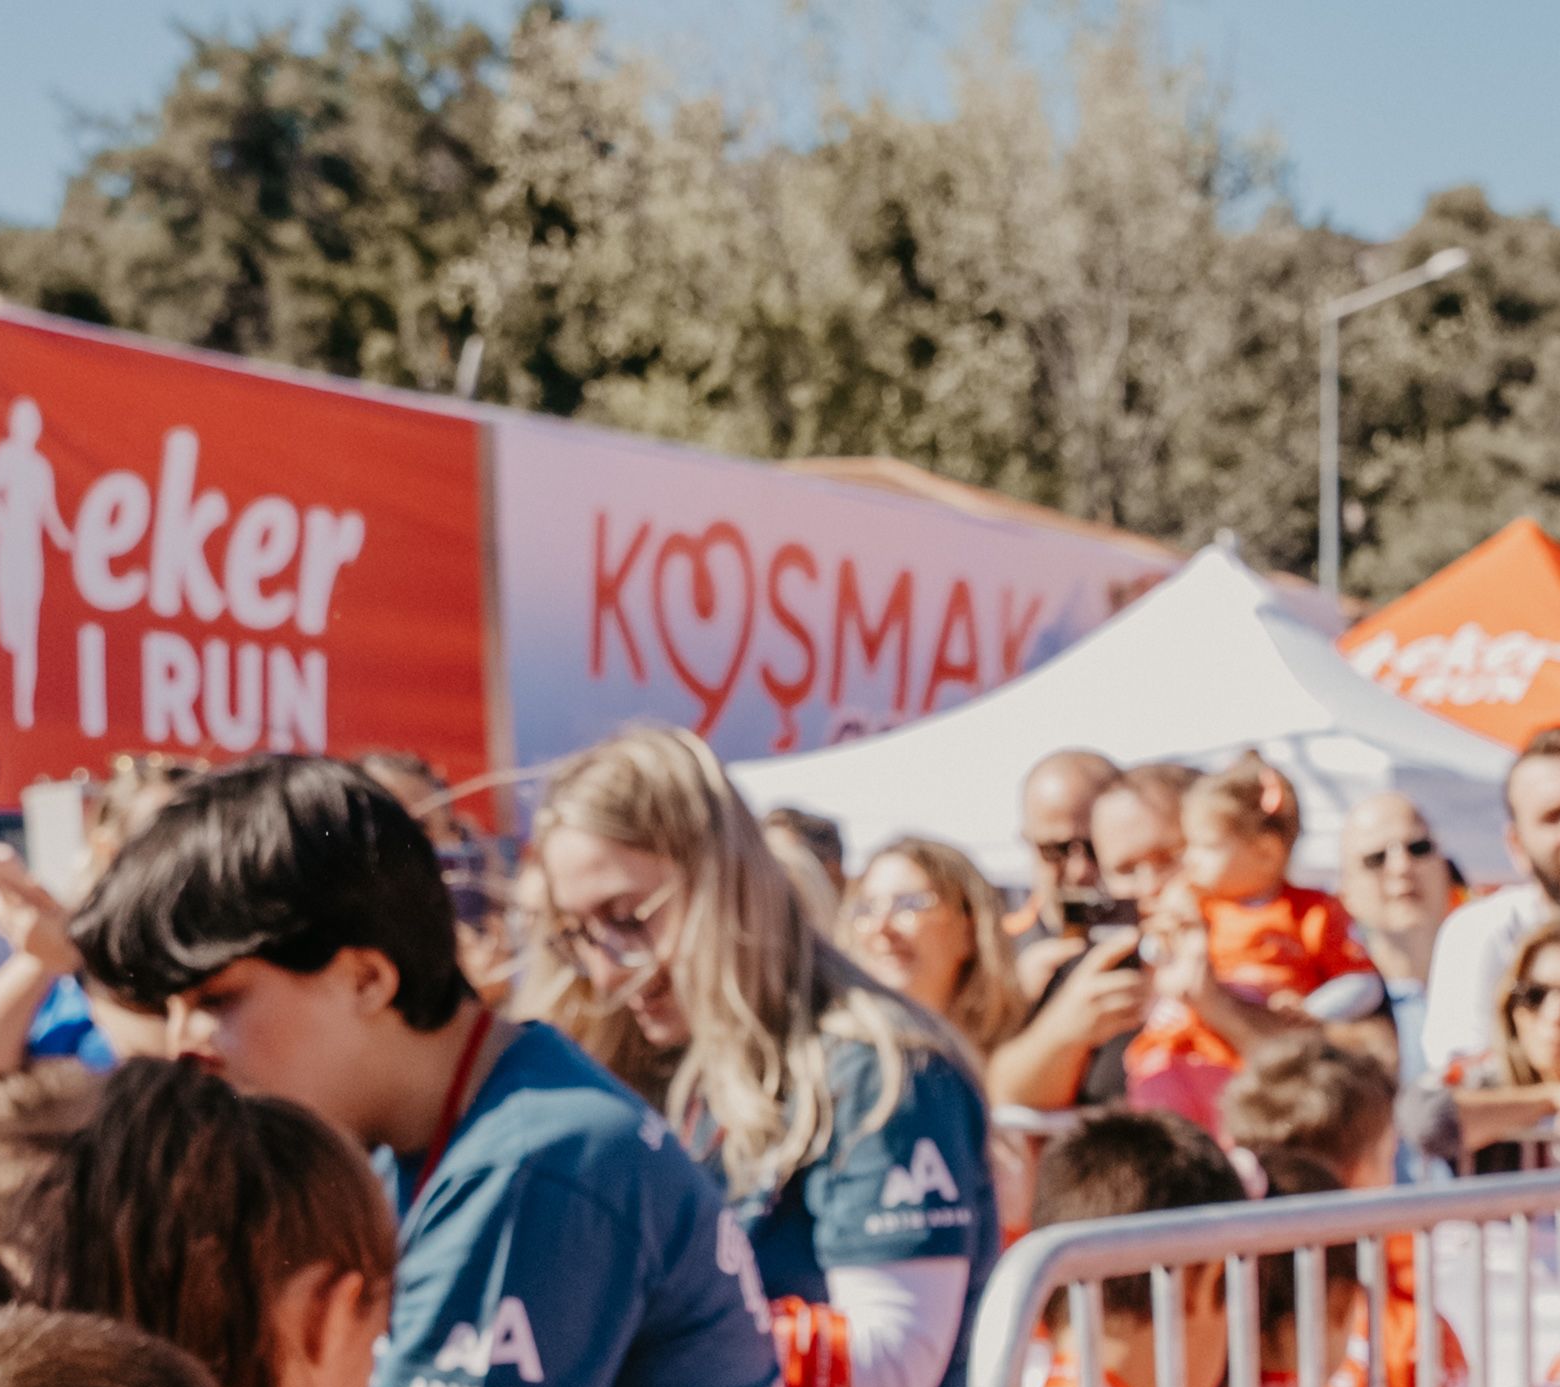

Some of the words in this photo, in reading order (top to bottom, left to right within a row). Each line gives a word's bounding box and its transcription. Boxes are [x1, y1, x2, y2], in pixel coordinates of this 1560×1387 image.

[72, 426, 366, 637] eker
[76, 622, 108, 738] I
[142, 636, 330, 755] RUN
